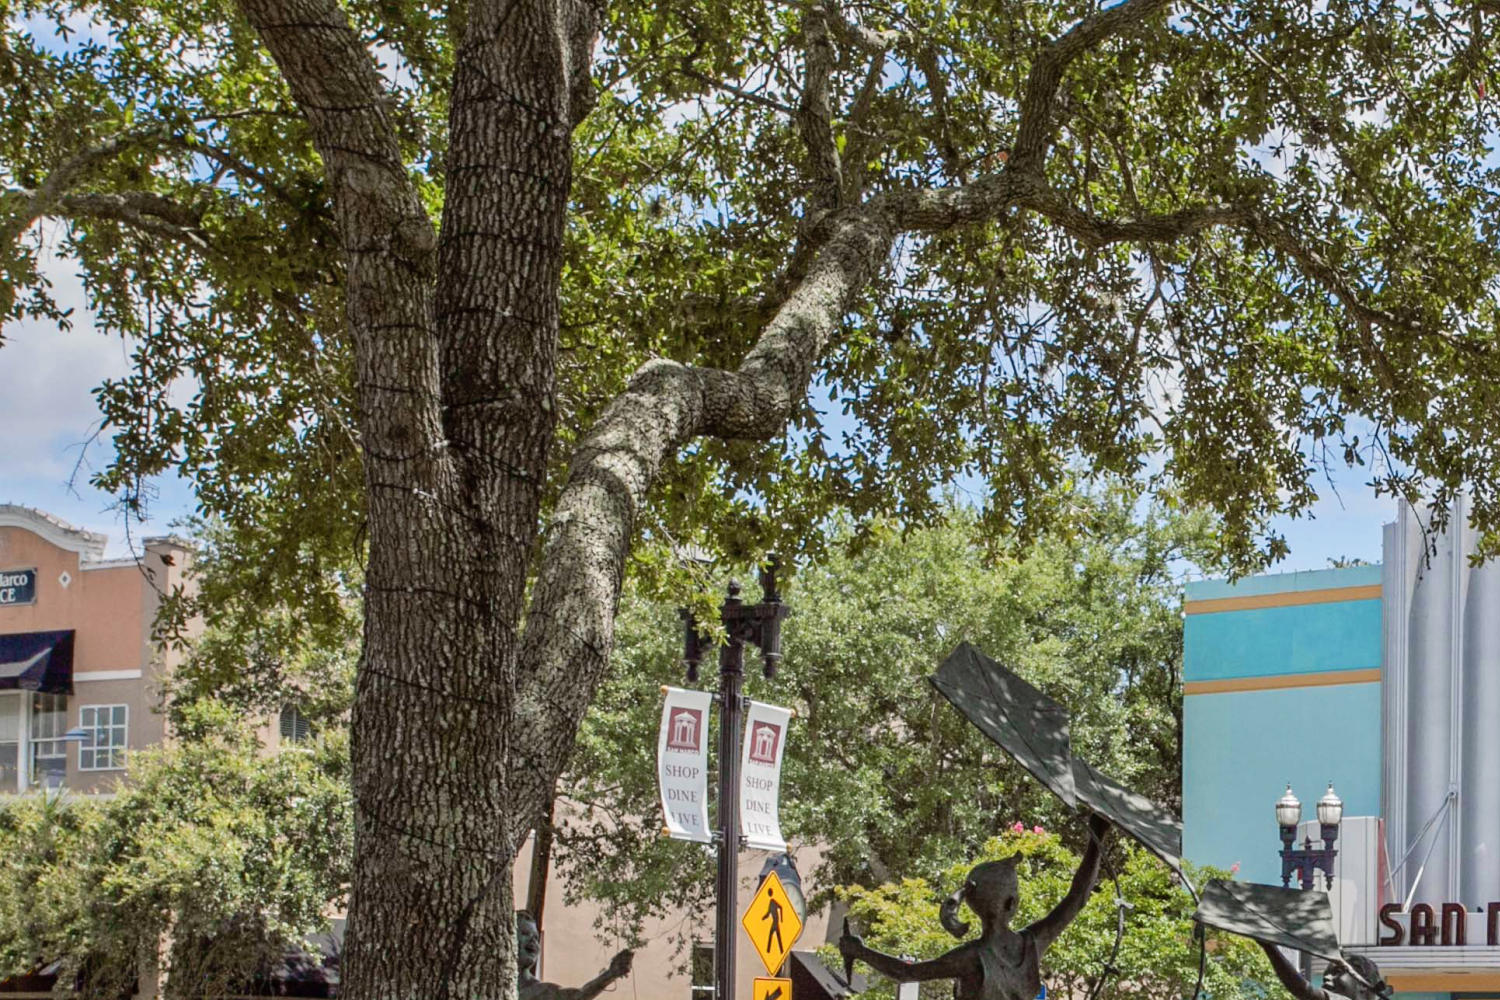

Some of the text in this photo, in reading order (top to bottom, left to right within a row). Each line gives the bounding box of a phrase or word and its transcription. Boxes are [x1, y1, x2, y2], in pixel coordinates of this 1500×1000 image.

[665, 764, 700, 779] SHOP
[745, 775, 773, 791] SHOP
[668, 788, 698, 803] DINE
[746, 799, 771, 814] DINE
[747, 822, 772, 836] LIVE
[1379, 902, 1468, 946] SAN
